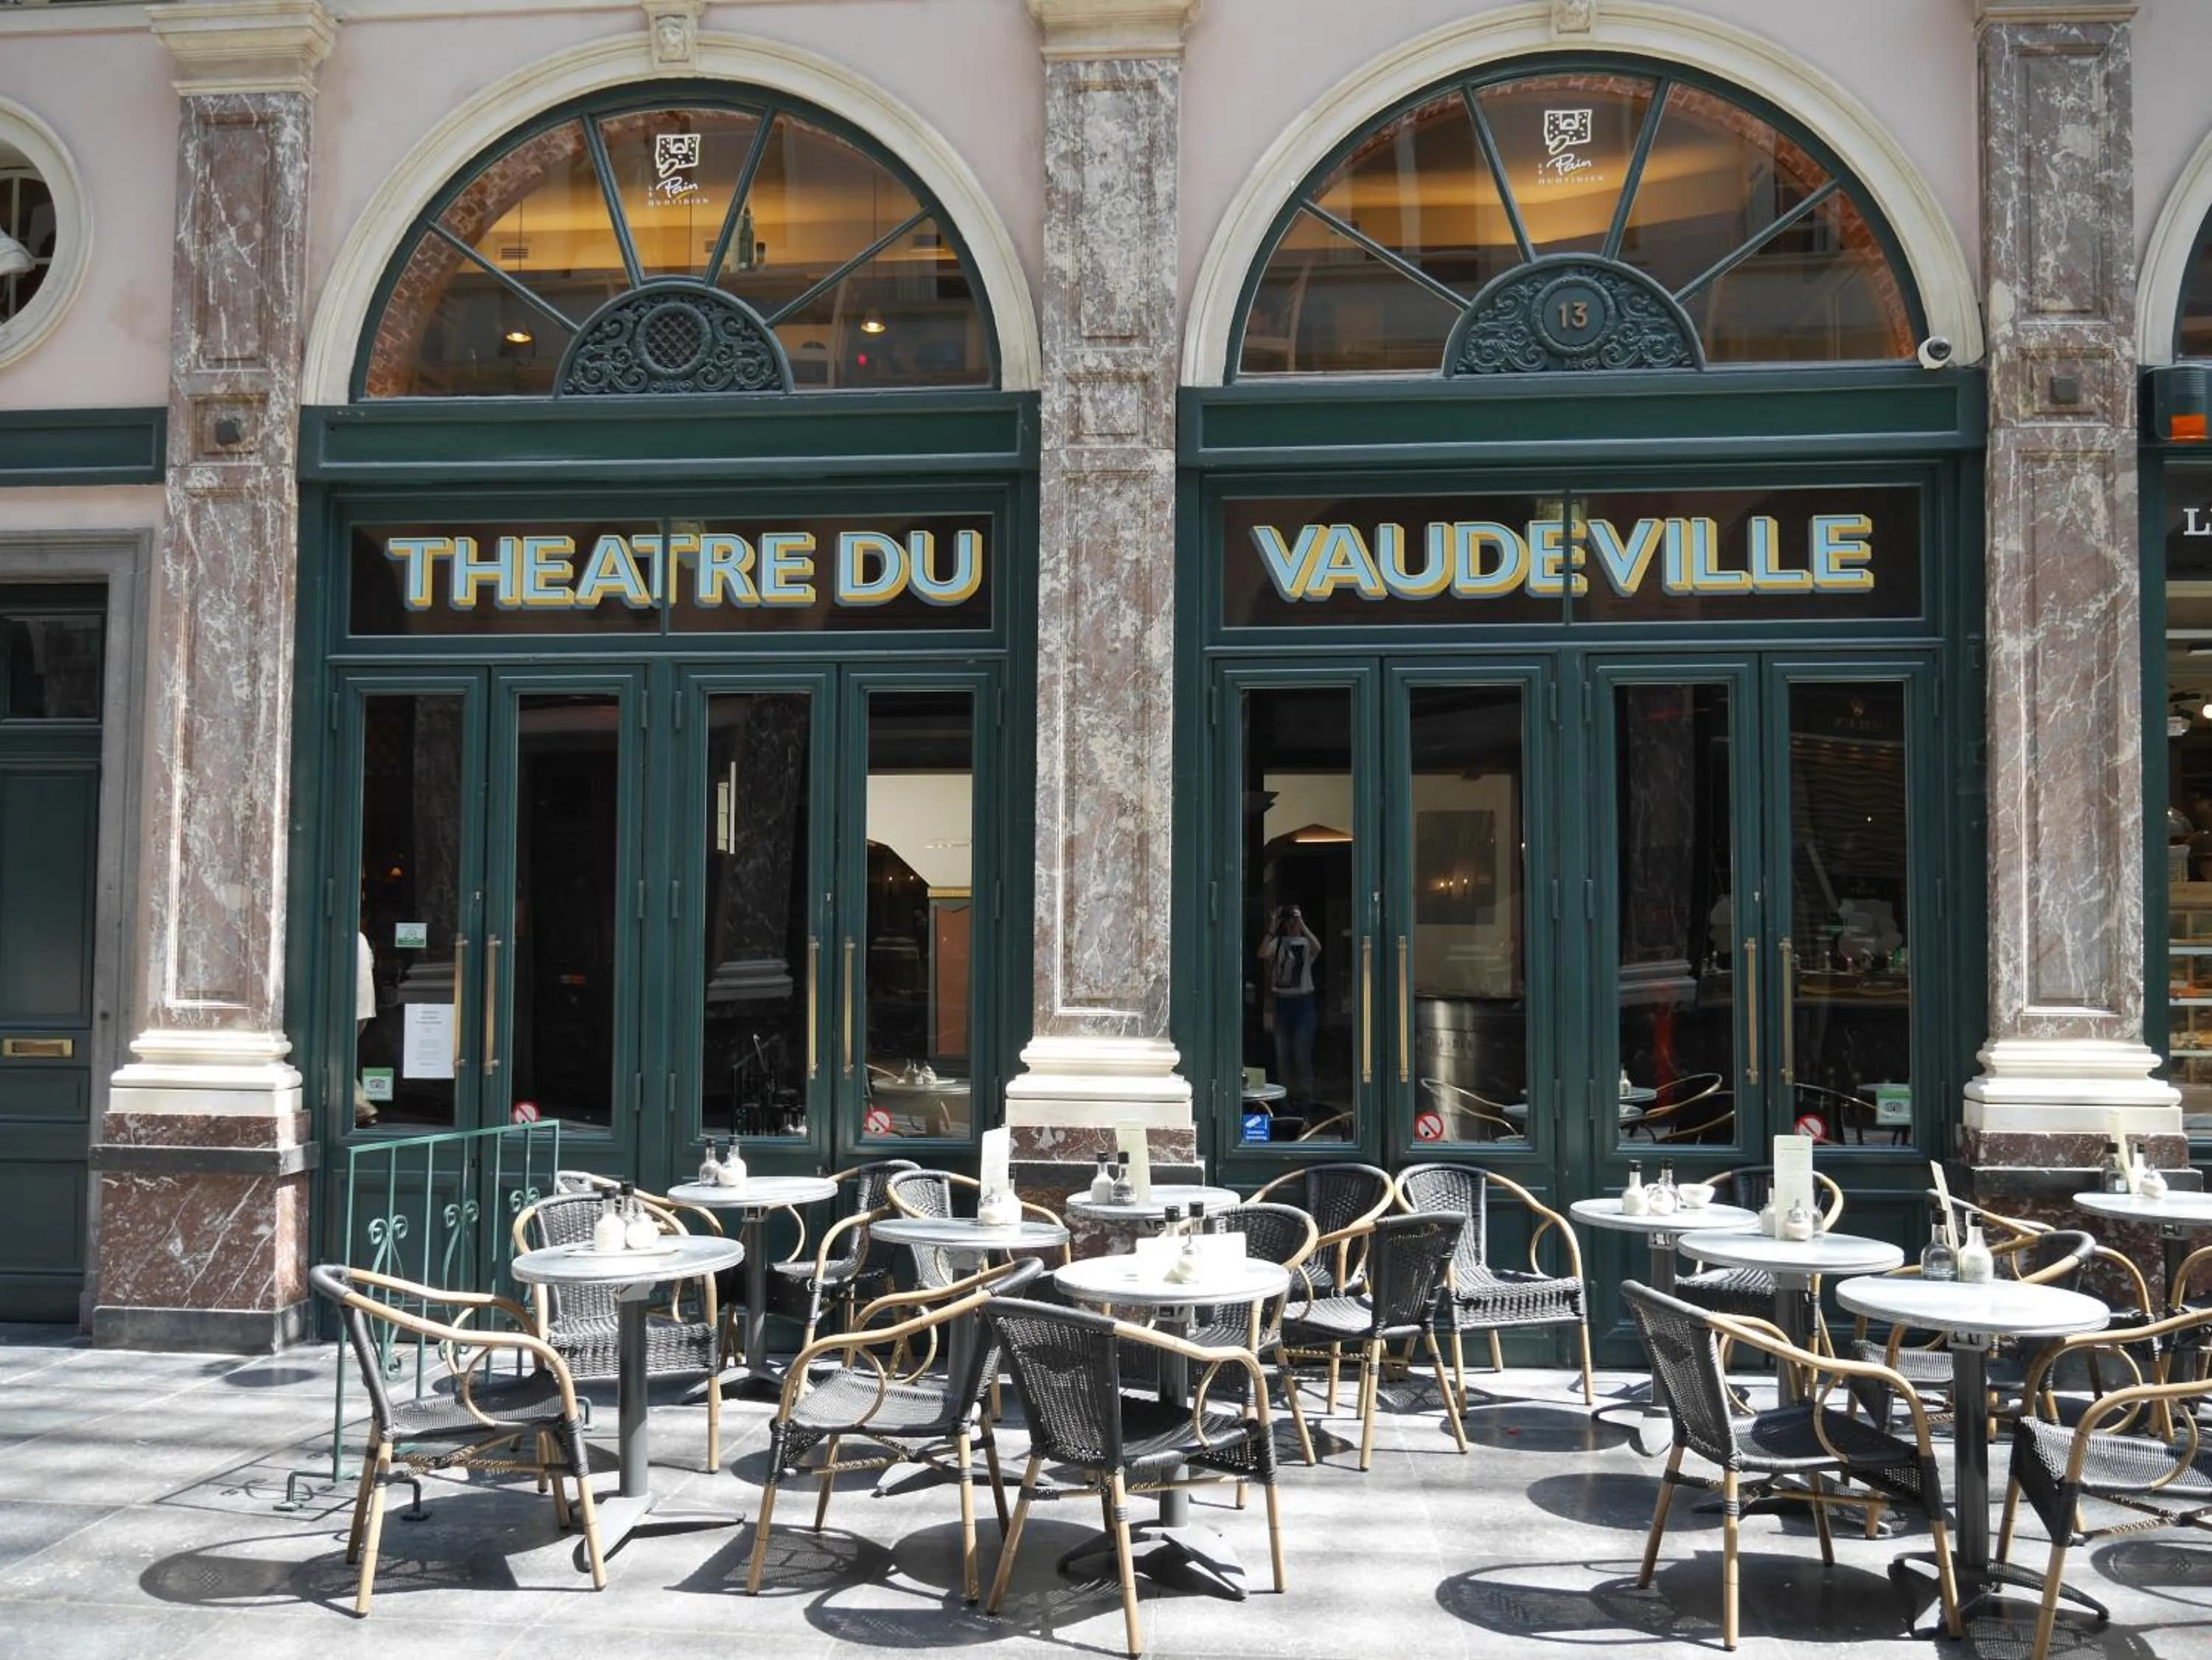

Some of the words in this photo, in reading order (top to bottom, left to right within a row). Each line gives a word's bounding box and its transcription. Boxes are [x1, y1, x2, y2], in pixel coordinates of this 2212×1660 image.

[1547, 153, 1593, 175] Pain
[655, 176, 698, 198] Pain
[1558, 301, 1588, 328] 13
[386, 533, 815, 610] THEATRE
[835, 530, 982, 607] DU
[1249, 515, 1874, 601] VAUDEVILLE
